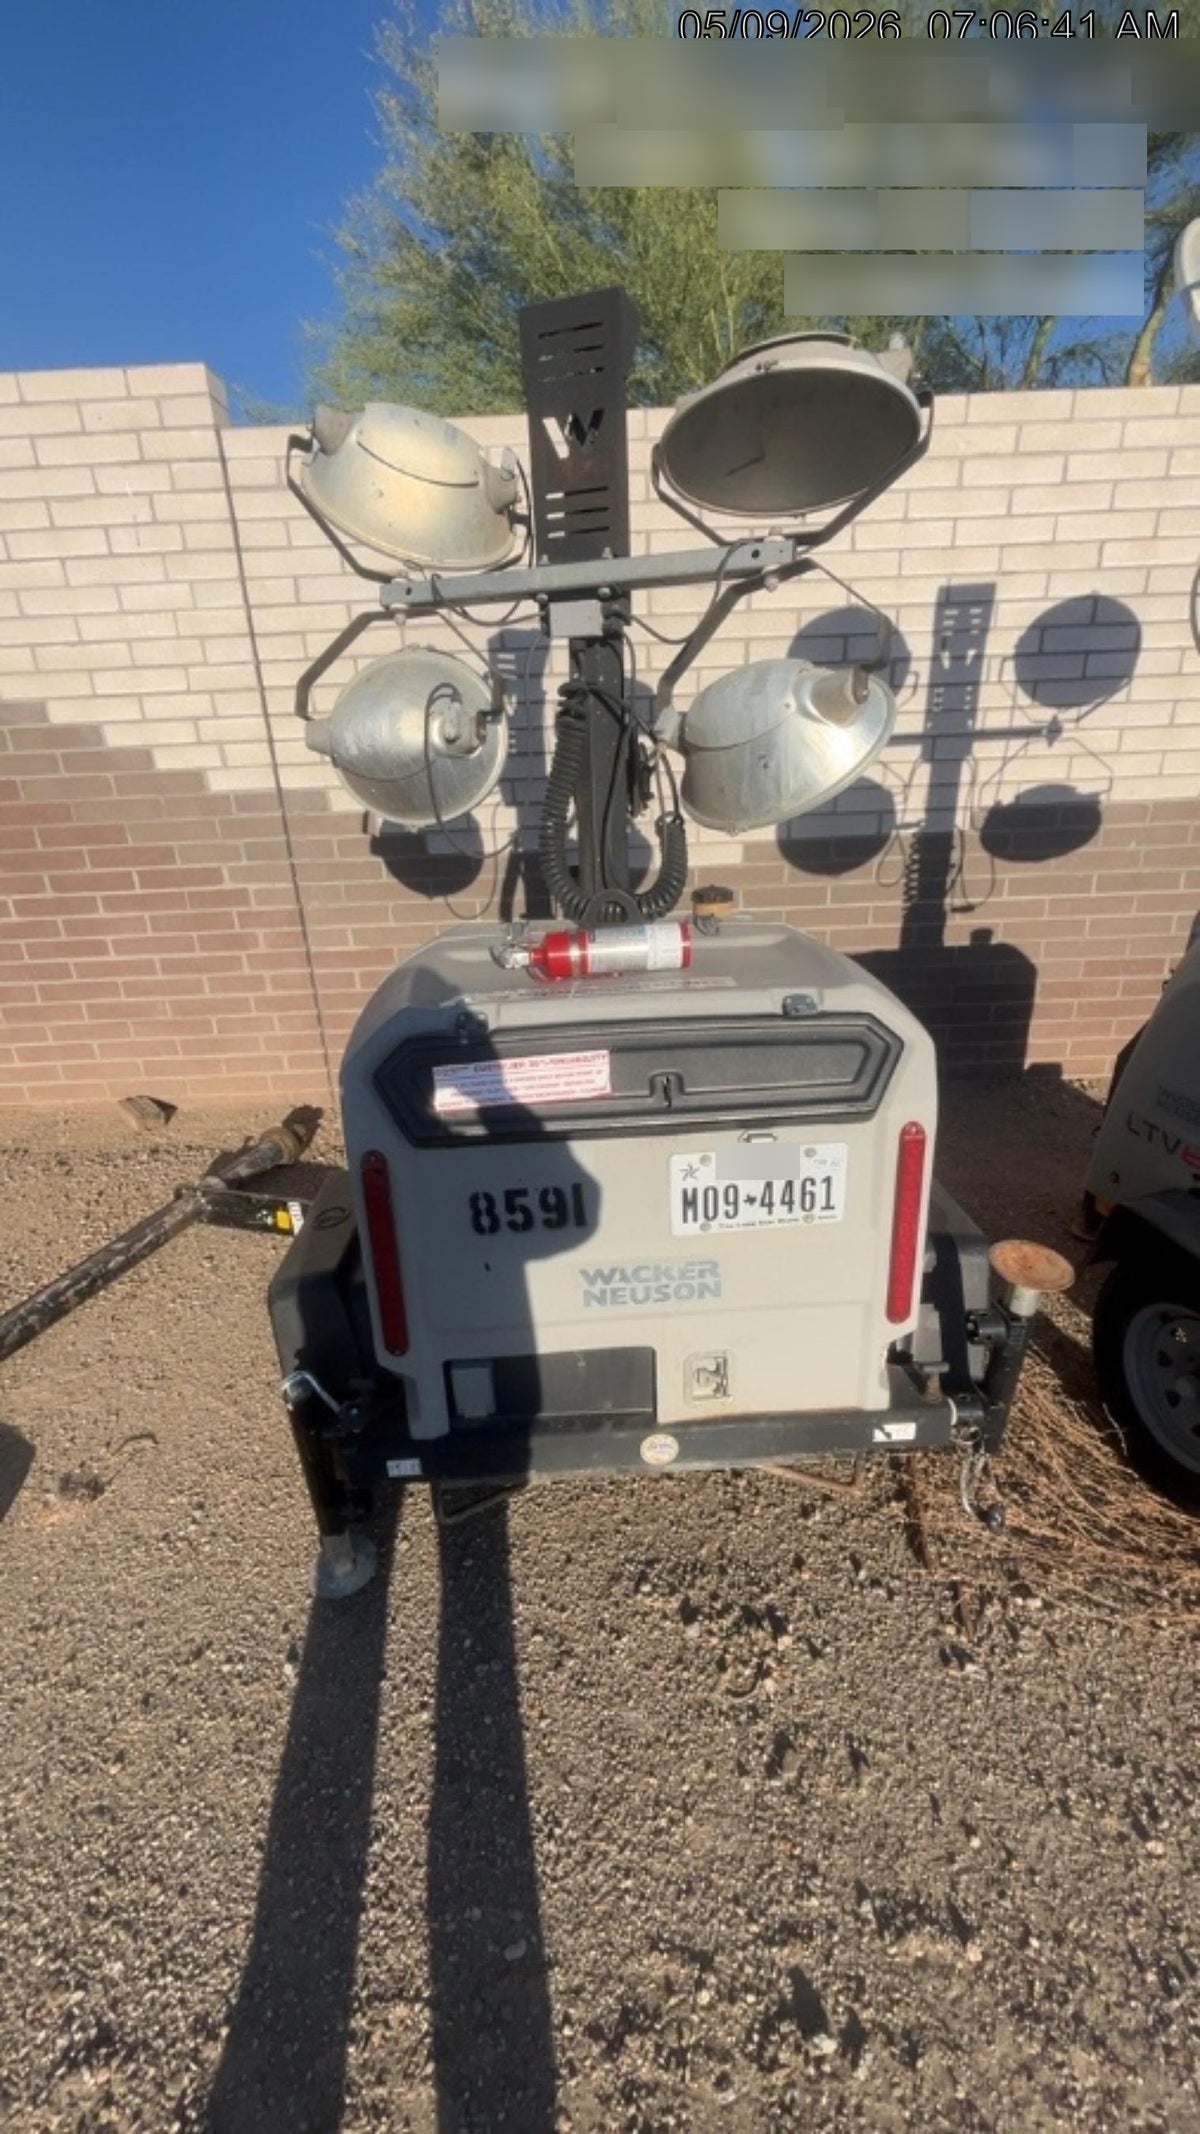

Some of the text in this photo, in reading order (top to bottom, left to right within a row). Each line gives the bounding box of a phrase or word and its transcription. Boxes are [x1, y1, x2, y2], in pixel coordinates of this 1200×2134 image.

[468, 1183, 588, 1235] 8591
[579, 1260, 720, 1286] WACKER
[583, 1279, 722, 1308] NEUSON
